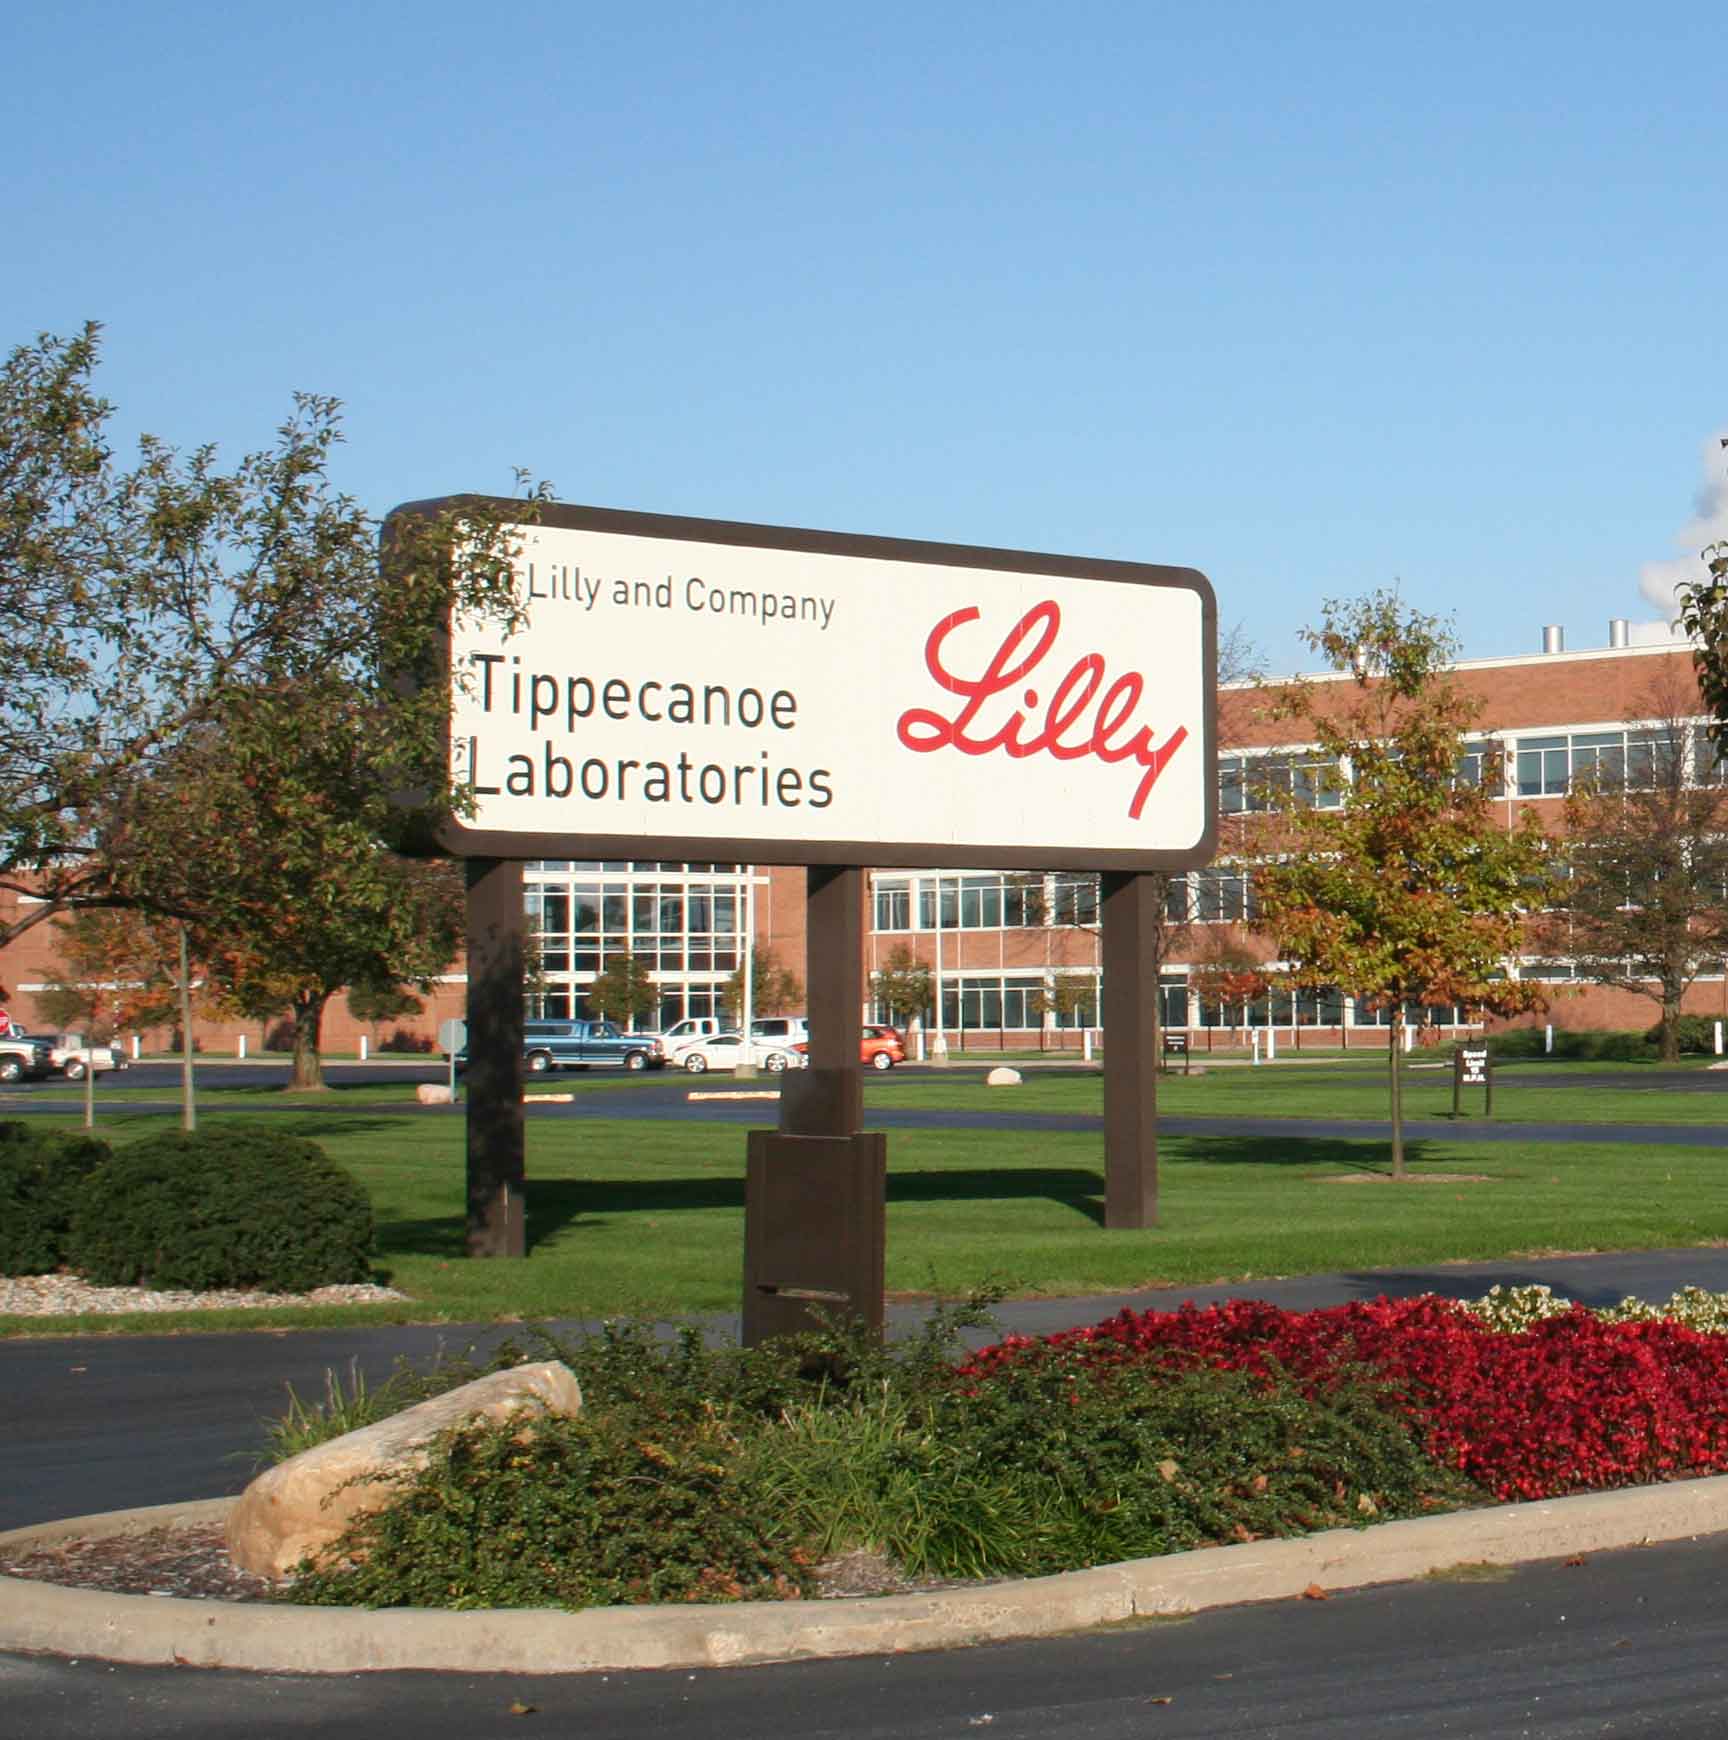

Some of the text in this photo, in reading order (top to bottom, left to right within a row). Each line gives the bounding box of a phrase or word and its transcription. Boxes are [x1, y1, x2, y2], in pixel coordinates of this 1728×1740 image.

[528, 562, 836, 632] Lilly and Company
[473, 651, 799, 733] Tippecanoe
[897, 598, 1188, 821] Lilly
[469, 735, 834, 810] Laboratories
[1462, 1049, 1488, 1059] Speed
[1465, 1059, 1486, 1067] Limit
